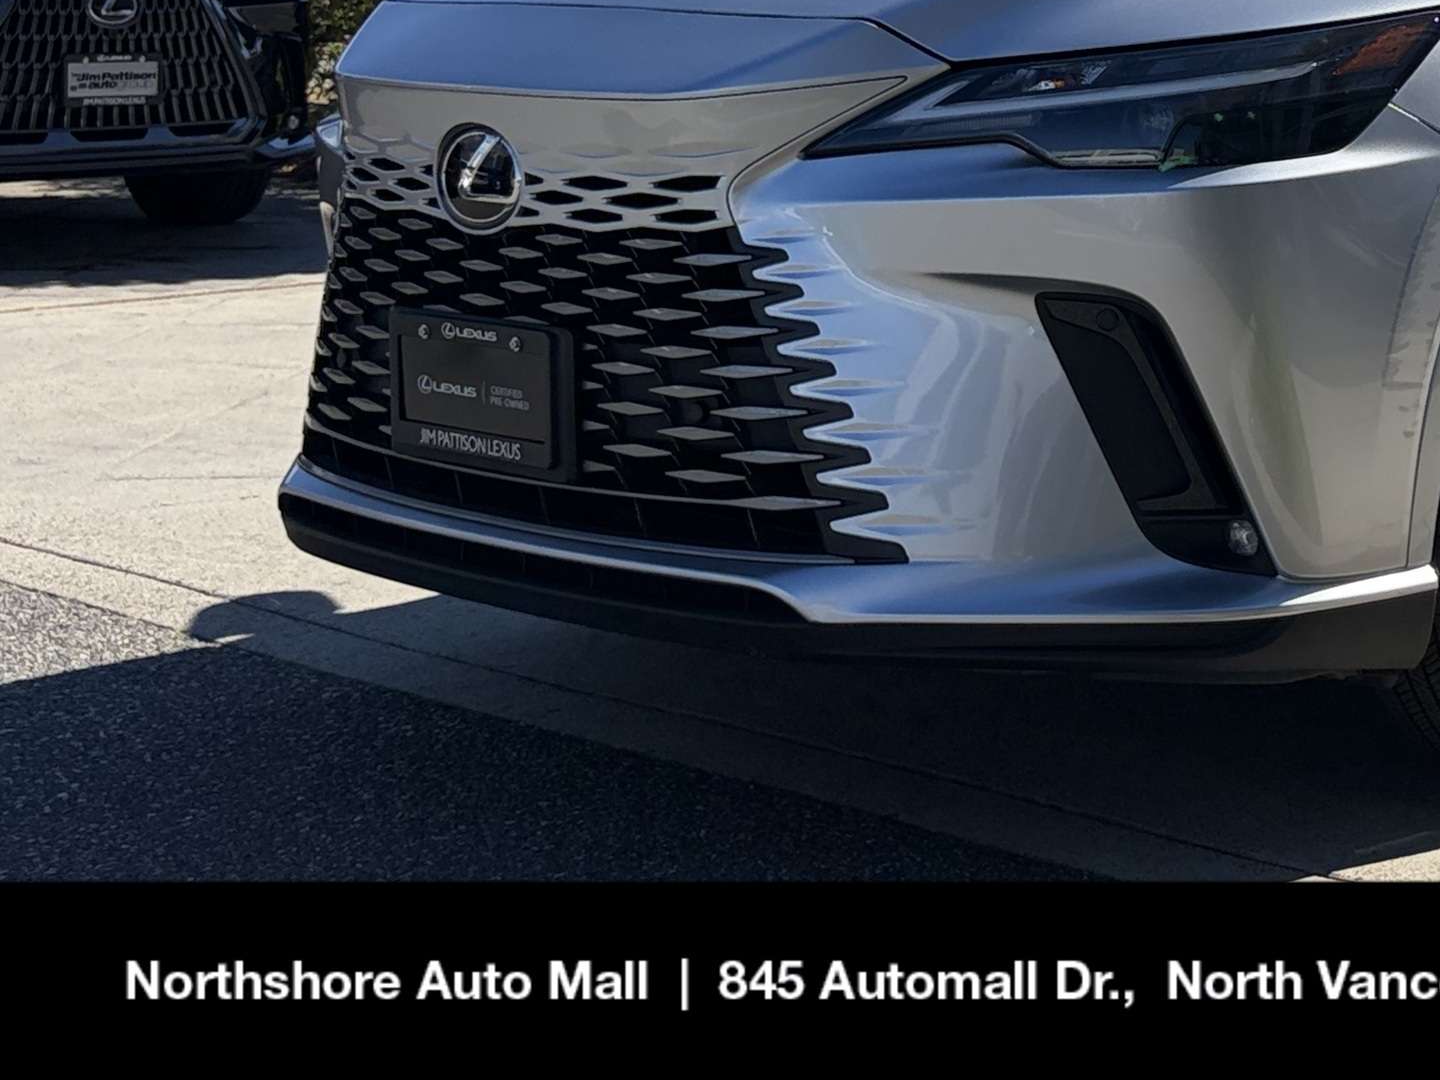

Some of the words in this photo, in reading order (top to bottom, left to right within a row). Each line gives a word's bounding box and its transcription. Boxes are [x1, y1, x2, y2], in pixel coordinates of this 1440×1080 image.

[102, 70, 157, 82] Pattison
[456, 326, 497, 342] LEXUS
[433, 380, 477, 398] LEXUS
[438, 430, 486, 453] PATTISON
[487, 439, 521, 460] LEXUS
